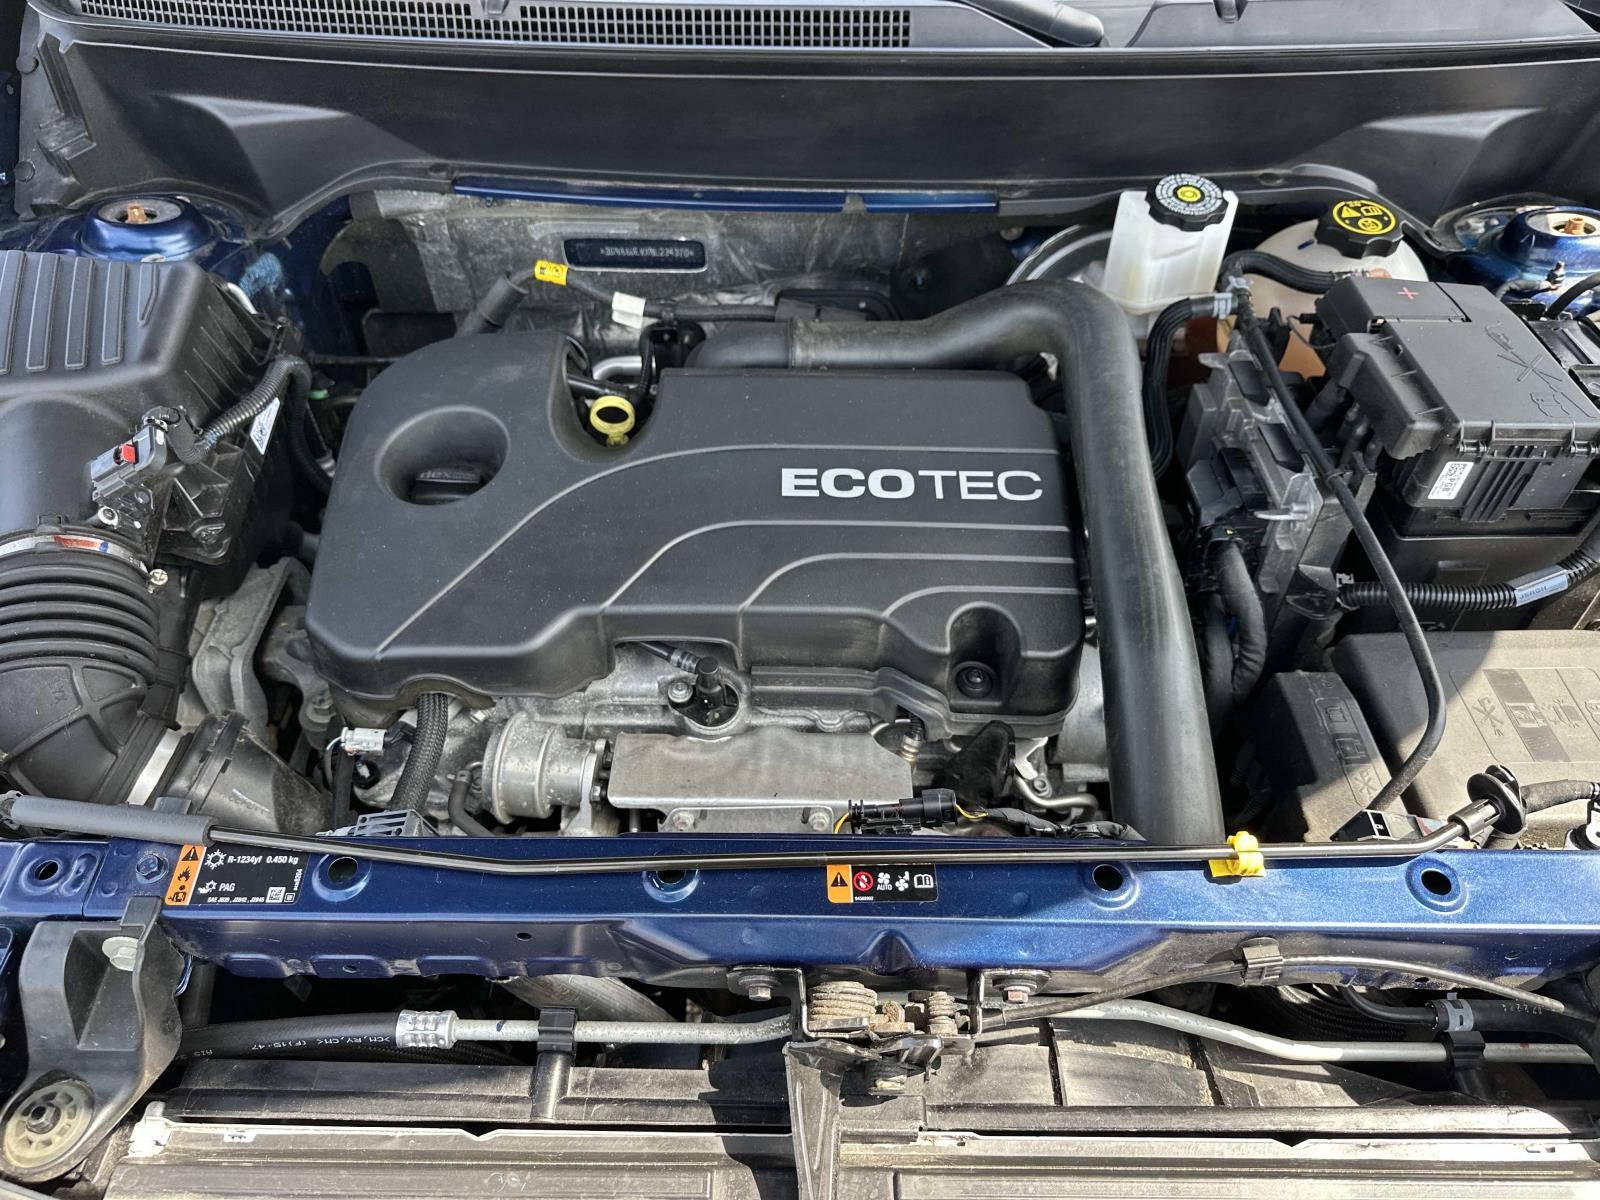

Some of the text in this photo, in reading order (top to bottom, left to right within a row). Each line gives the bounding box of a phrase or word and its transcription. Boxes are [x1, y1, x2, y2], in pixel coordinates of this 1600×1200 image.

[781, 468, 1043, 500] ECOTEC
[227, 855, 299, 865] R-1234yf 0.450 kg
[219, 883, 236, 891] PAG
